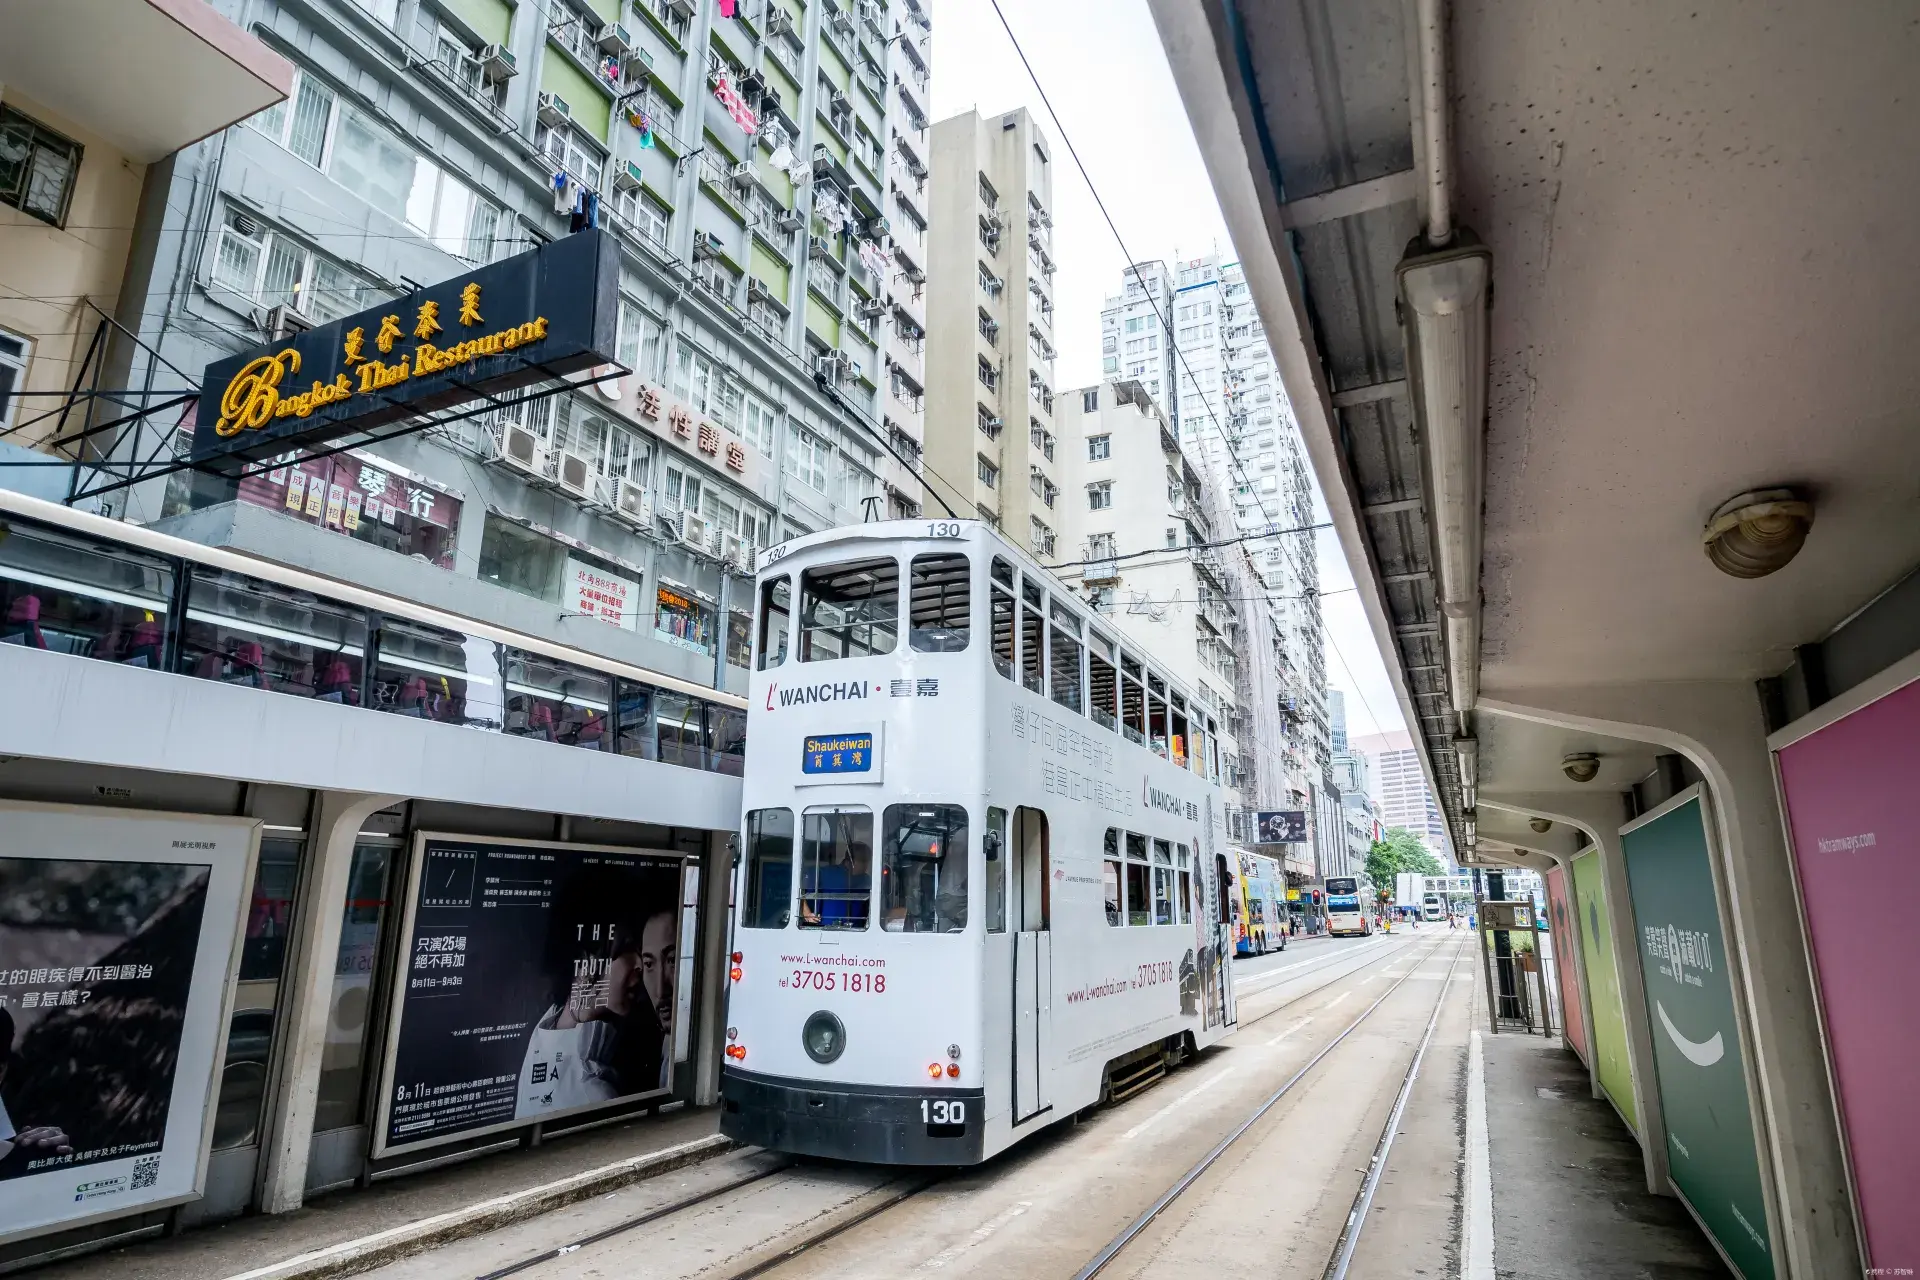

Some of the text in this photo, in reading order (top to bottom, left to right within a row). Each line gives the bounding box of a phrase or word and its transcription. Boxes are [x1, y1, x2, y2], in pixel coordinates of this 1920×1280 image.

[215, 316, 549, 437] Bangkok Thai Restaurant
[251, 462, 396, 522] 童成人音樂課程
[288, 491, 358, 527] 現正招生
[926, 523, 961, 538] 130
[767, 545, 786, 565] 130
[807, 738, 871, 754] Shaukeiwan
[813, 751, 863, 768] 筲箕灣
[577, 924, 616, 941] THE
[416, 936, 467, 952] 只演25場
[414, 952, 466, 969] 絕不再加
[573, 957, 613, 977] TRUTH
[780, 953, 886, 968] www.L-wanchai.com
[778, 970, 886, 993] tel 3705 1818
[1137, 963, 1157, 989] 3705
[1157, 960, 1173, 984] 1818
[569, 979, 611, 1011] 謊言
[920, 1100, 965, 1124] 130
